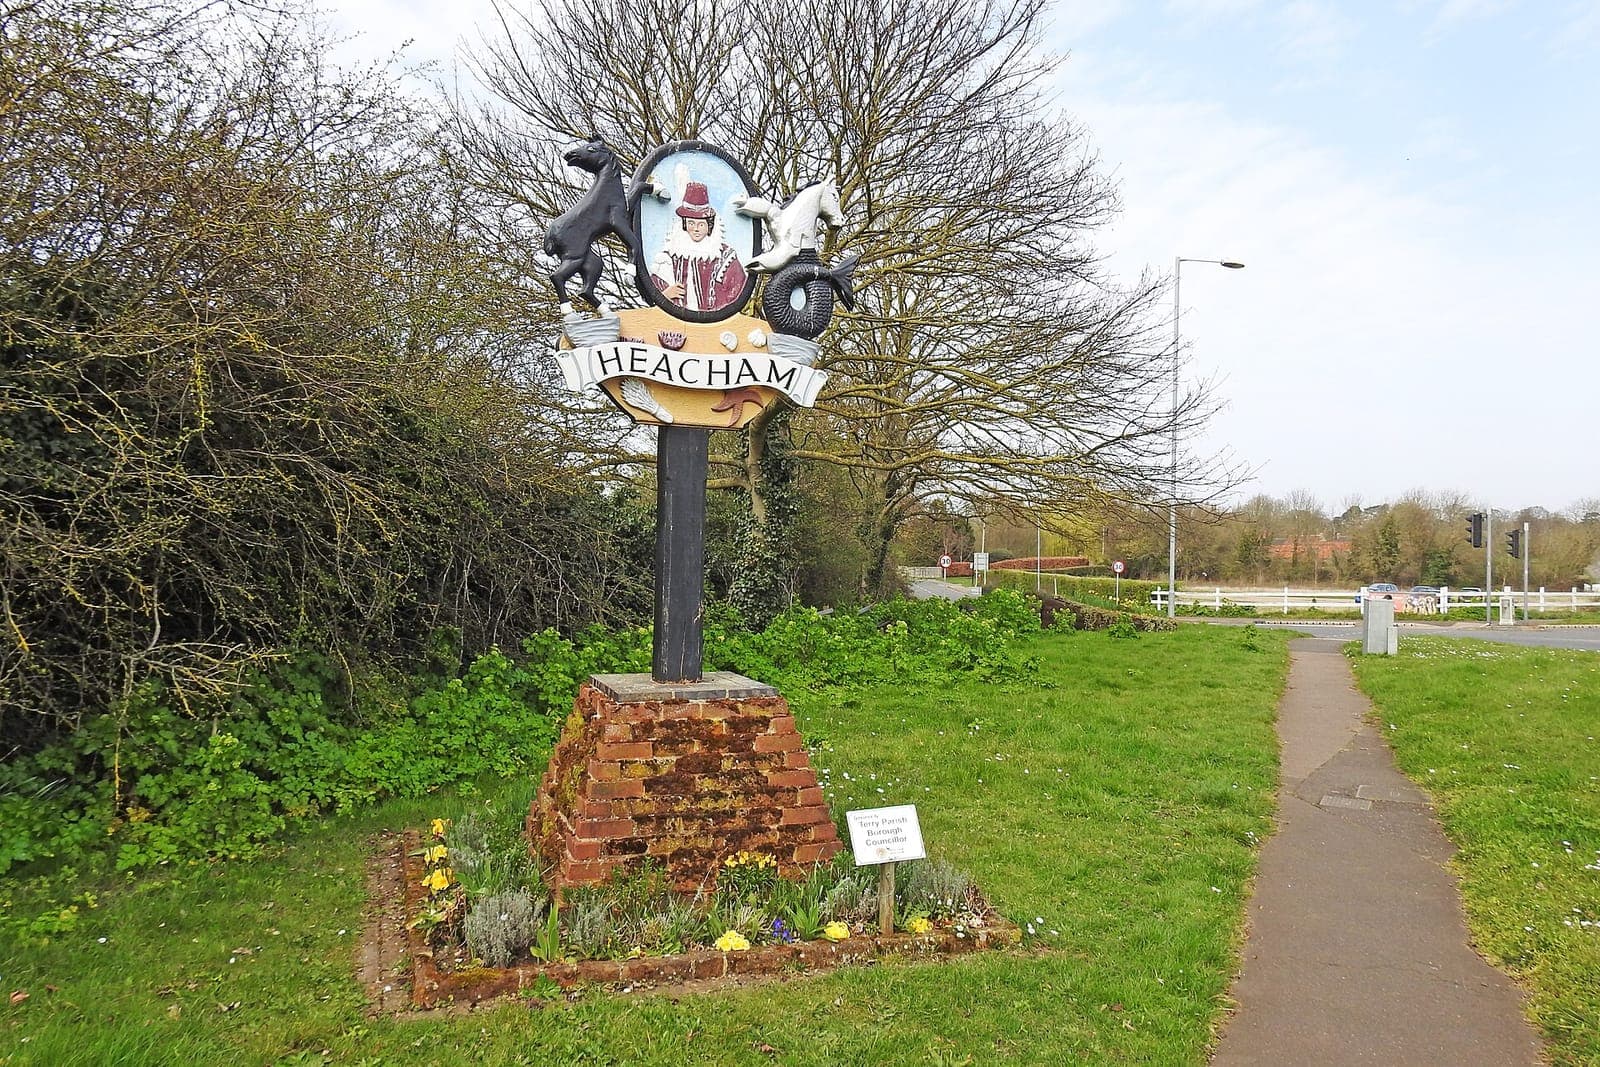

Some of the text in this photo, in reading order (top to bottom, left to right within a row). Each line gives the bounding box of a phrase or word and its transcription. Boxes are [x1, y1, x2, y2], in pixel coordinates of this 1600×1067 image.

[597, 347, 797, 390] HEACHAM
[881, 817, 908, 825] Parish
[867, 827, 903, 837] Borough
[865, 836, 907, 847] Councillor
